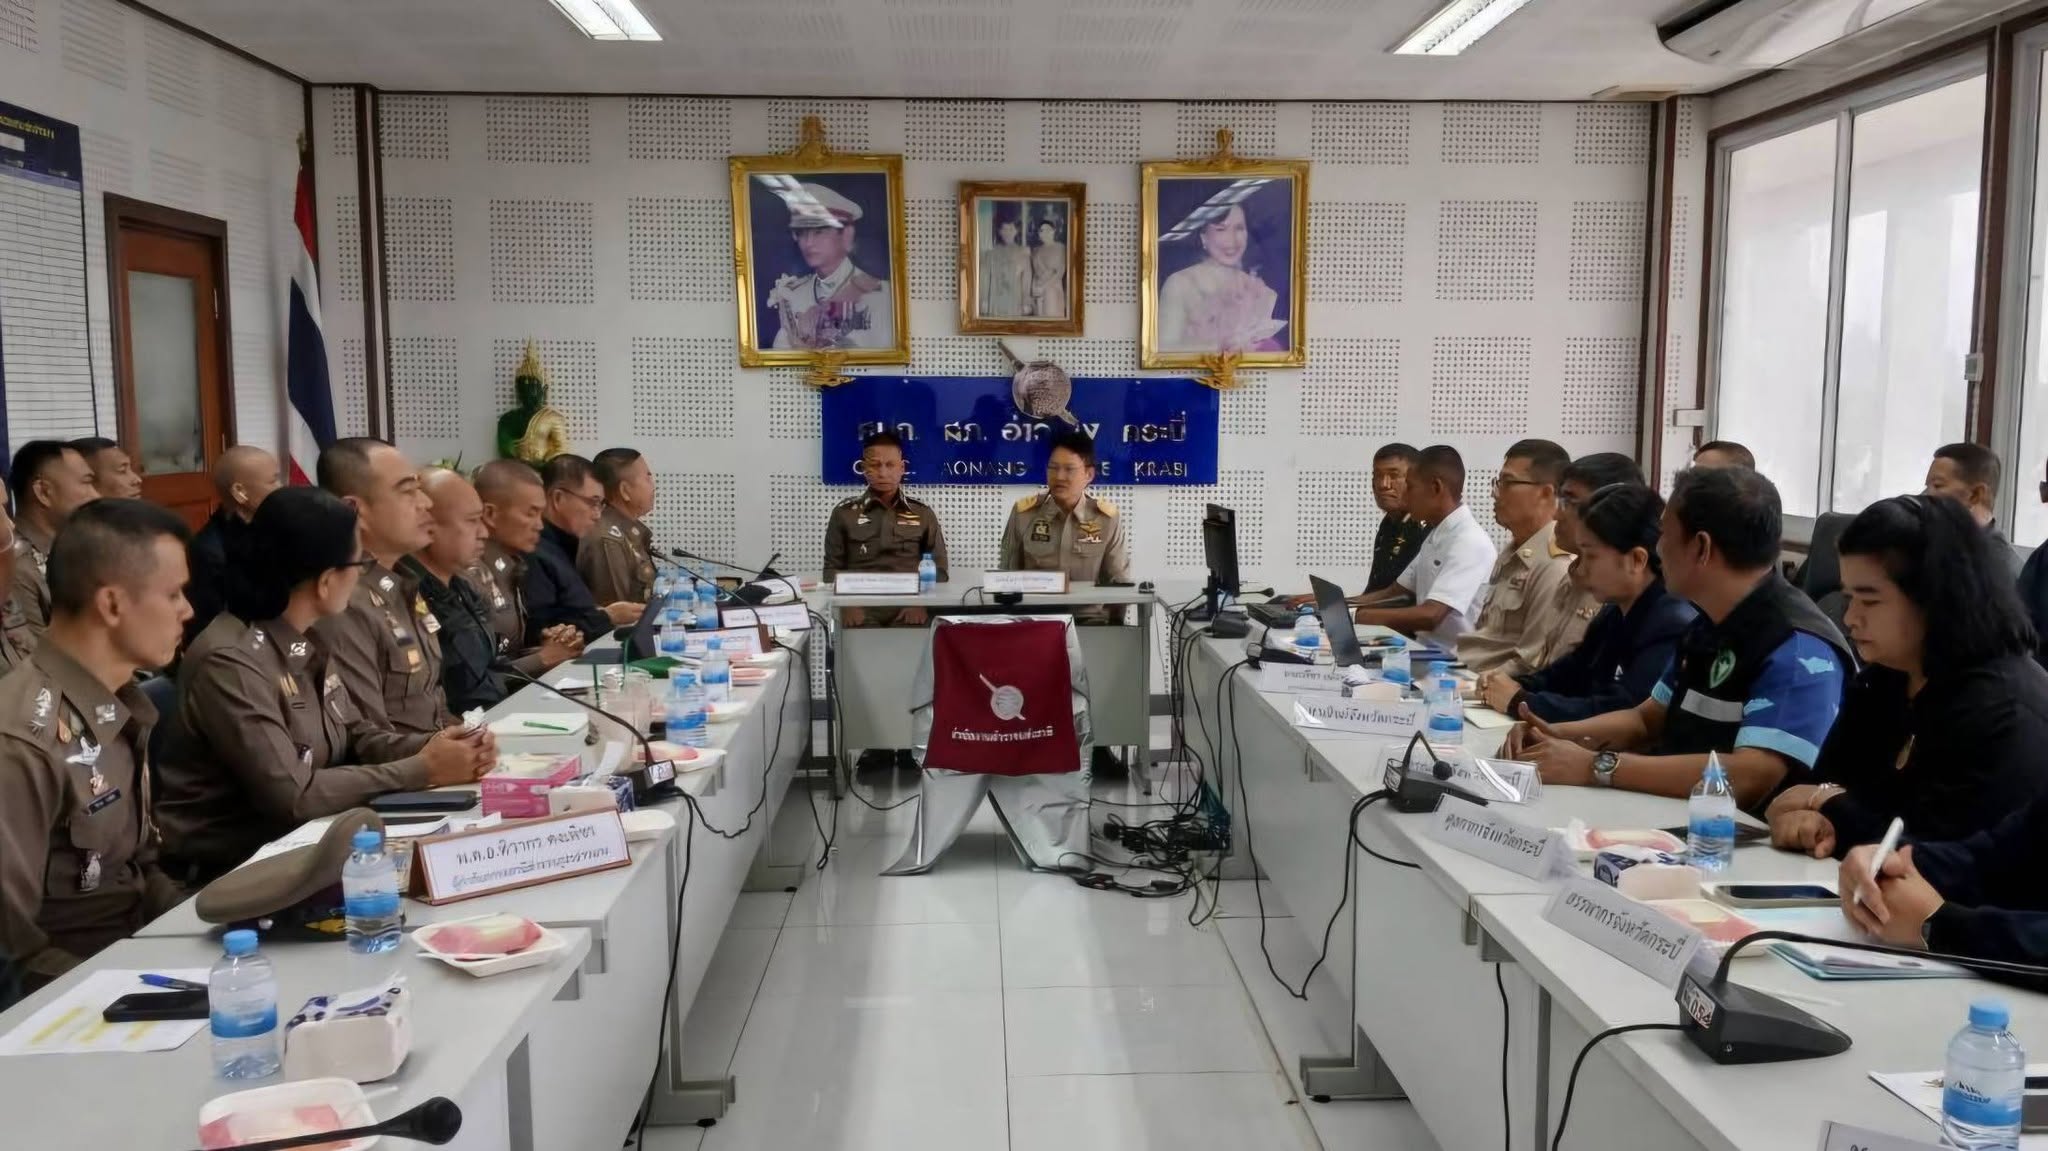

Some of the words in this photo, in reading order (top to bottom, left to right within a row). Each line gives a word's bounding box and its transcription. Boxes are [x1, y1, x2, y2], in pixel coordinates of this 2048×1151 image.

[1122, 411, 1186, 442] กระบี่
[942, 460, 1027, 476] AONANG
[1134, 460, 1187, 476] KRABI
